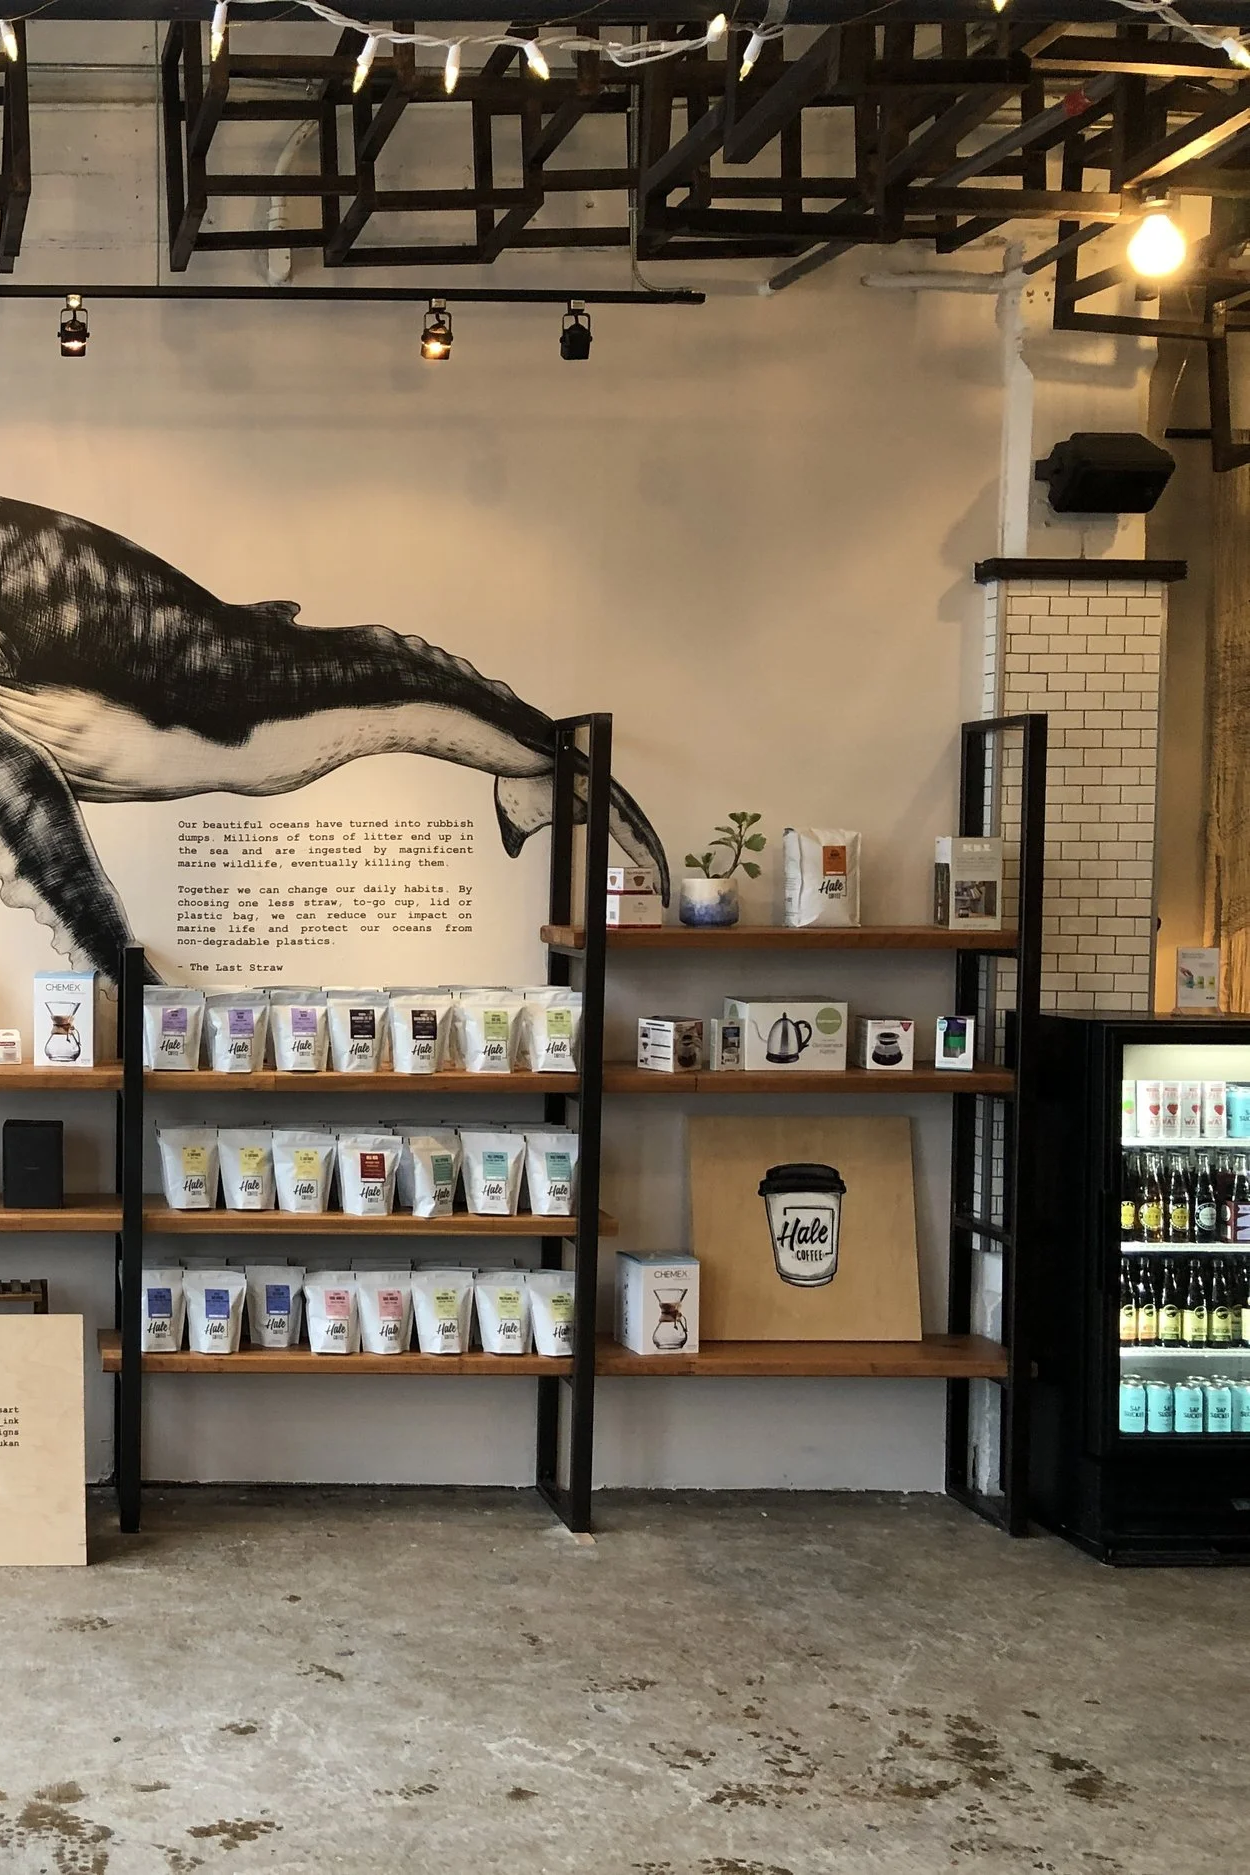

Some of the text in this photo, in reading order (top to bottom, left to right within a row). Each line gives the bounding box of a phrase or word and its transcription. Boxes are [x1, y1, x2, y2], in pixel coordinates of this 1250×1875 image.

[178, 820, 197, 829] Our
[202, 819, 263, 829] beautiful
[316, 819, 342, 829] have
[350, 819, 388, 829] turned
[393, 819, 421, 828] into
[427, 819, 474, 828] rubbish
[178, 832, 473, 845] dumps. Millions of tons of litter end up in
[179, 845, 197, 855] the
[242, 845, 262, 855] and
[309, 845, 362, 857] ingested
[374, 845, 387, 857] by
[399, 845, 474, 857] magnificent
[178, 858, 449, 871] marine wildlife, eventually killing them.
[178, 884, 230, 897] Together
[288, 884, 328, 896] change
[336, 886, 356, 894] our
[363, 884, 396, 896] daily
[404, 884, 449, 893] habits.
[459, 884, 472, 896] By
[818, 879, 843, 894] Hale
[178, 898, 229, 910] choosing
[268, 897, 294, 907] less
[304, 897, 342, 910] straw,
[353, 897, 385, 909] to-go
[395, 899, 420, 909] cup,
[430, 897, 450, 907] lid
[178, 911, 222, 923] plastic
[233, 910, 258, 923] bag,
[327, 910, 366, 920] reduce
[377, 912, 397, 920] our
[408, 910, 448, 922] impact
[177, 923, 216, 933] marine
[228, 923, 255, 933] life
[268, 923, 289, 933] and
[301, 923, 348, 935] protect
[360, 925, 380, 933] our
[445, 923, 472, 932] from
[177, 936, 335, 948] non-degradable plastics.
[190, 962, 209, 972] The
[216, 962, 243, 972] Last
[249, 962, 283, 972] Straw
[45, 983, 81, 992] CHEMEX
[160, 1039, 181, 1052] Hale
[228, 1042, 249, 1055] Hale
[292, 1040, 312, 1052] Hale
[349, 1041, 370, 1055] Hale
[412, 1041, 432, 1055] Hale
[482, 1043, 503, 1055] Hale
[545, 1041, 567, 1054] Hale
[183, 1179, 203, 1191] Hale
[239, 1180, 259, 1192] Hale
[293, 1183, 314, 1195] Hale
[482, 1184, 502, 1195] Hale
[547, 1185, 568, 1196] Hale
[360, 1185, 381, 1198] Hale
[777, 1218, 829, 1250] Hale
[797, 1250, 823, 1261] COFFEE
[148, 1320, 167, 1334] Hale
[205, 1323, 224, 1335] Hale
[266, 1318, 285, 1330] Hale
[326, 1323, 345, 1335] Hale
[437, 1323, 456, 1335] Hale
[497, 1323, 517, 1335] Hale
